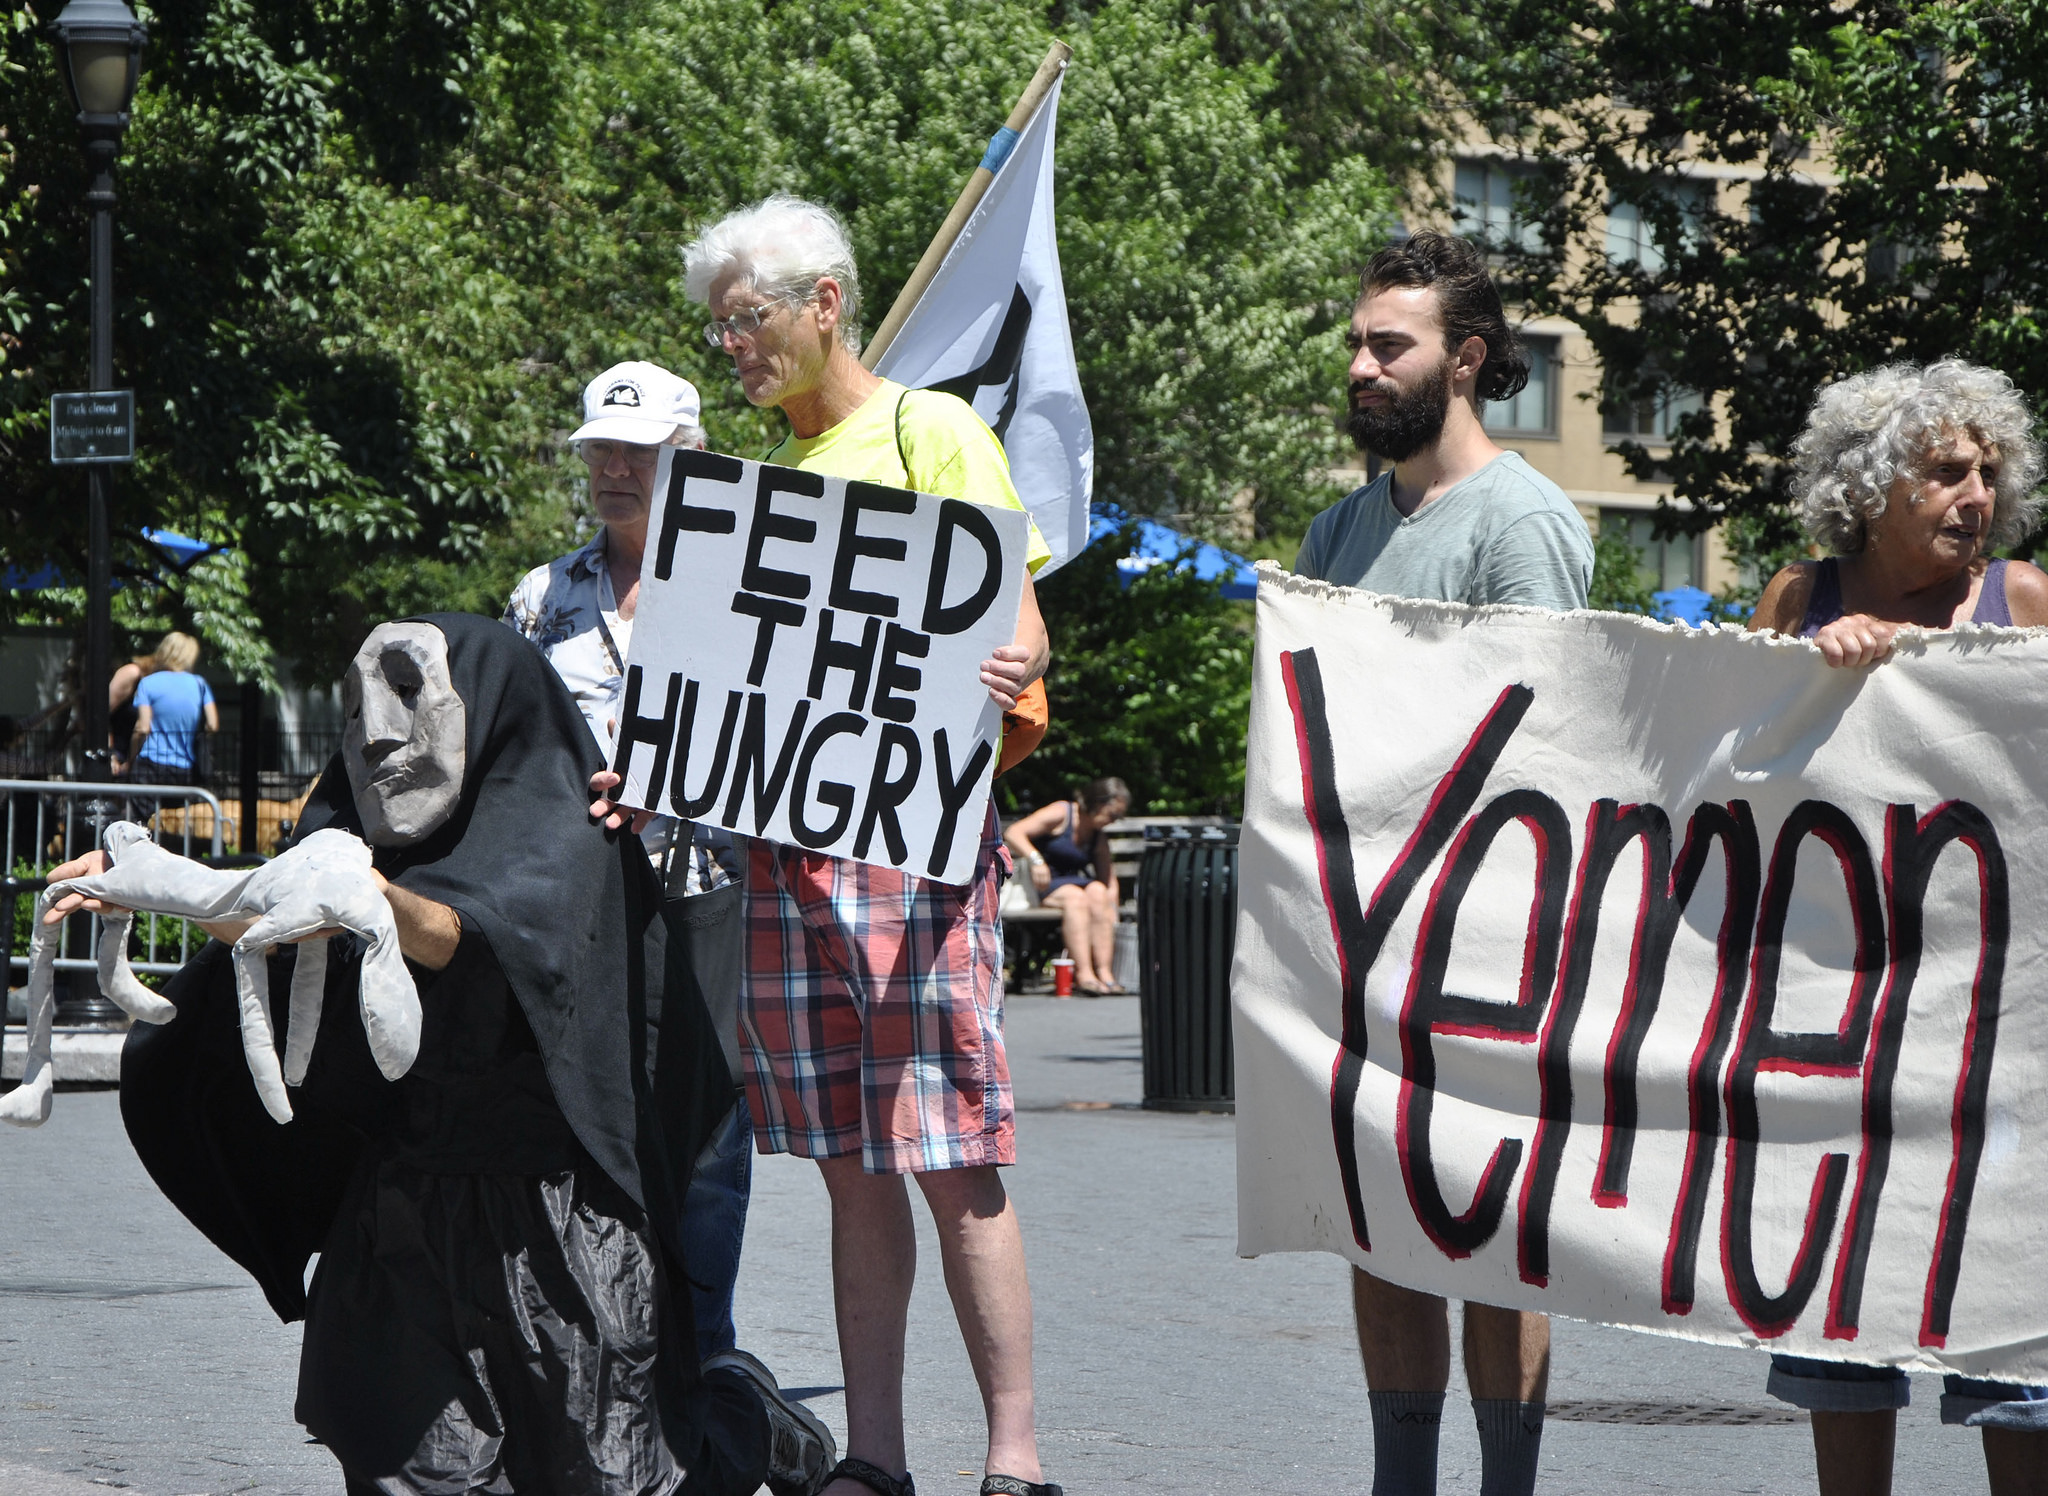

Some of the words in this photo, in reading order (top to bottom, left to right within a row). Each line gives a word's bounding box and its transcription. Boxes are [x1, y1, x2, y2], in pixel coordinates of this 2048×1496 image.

[67, 402, 86, 416] Park
[88, 401, 118, 415] closed
[654, 449, 1003, 635] FEED
[731, 591, 931, 723] THE
[607, 664, 993, 877] HUNGRY
[1280, 647, 2011, 1347] Yemen
